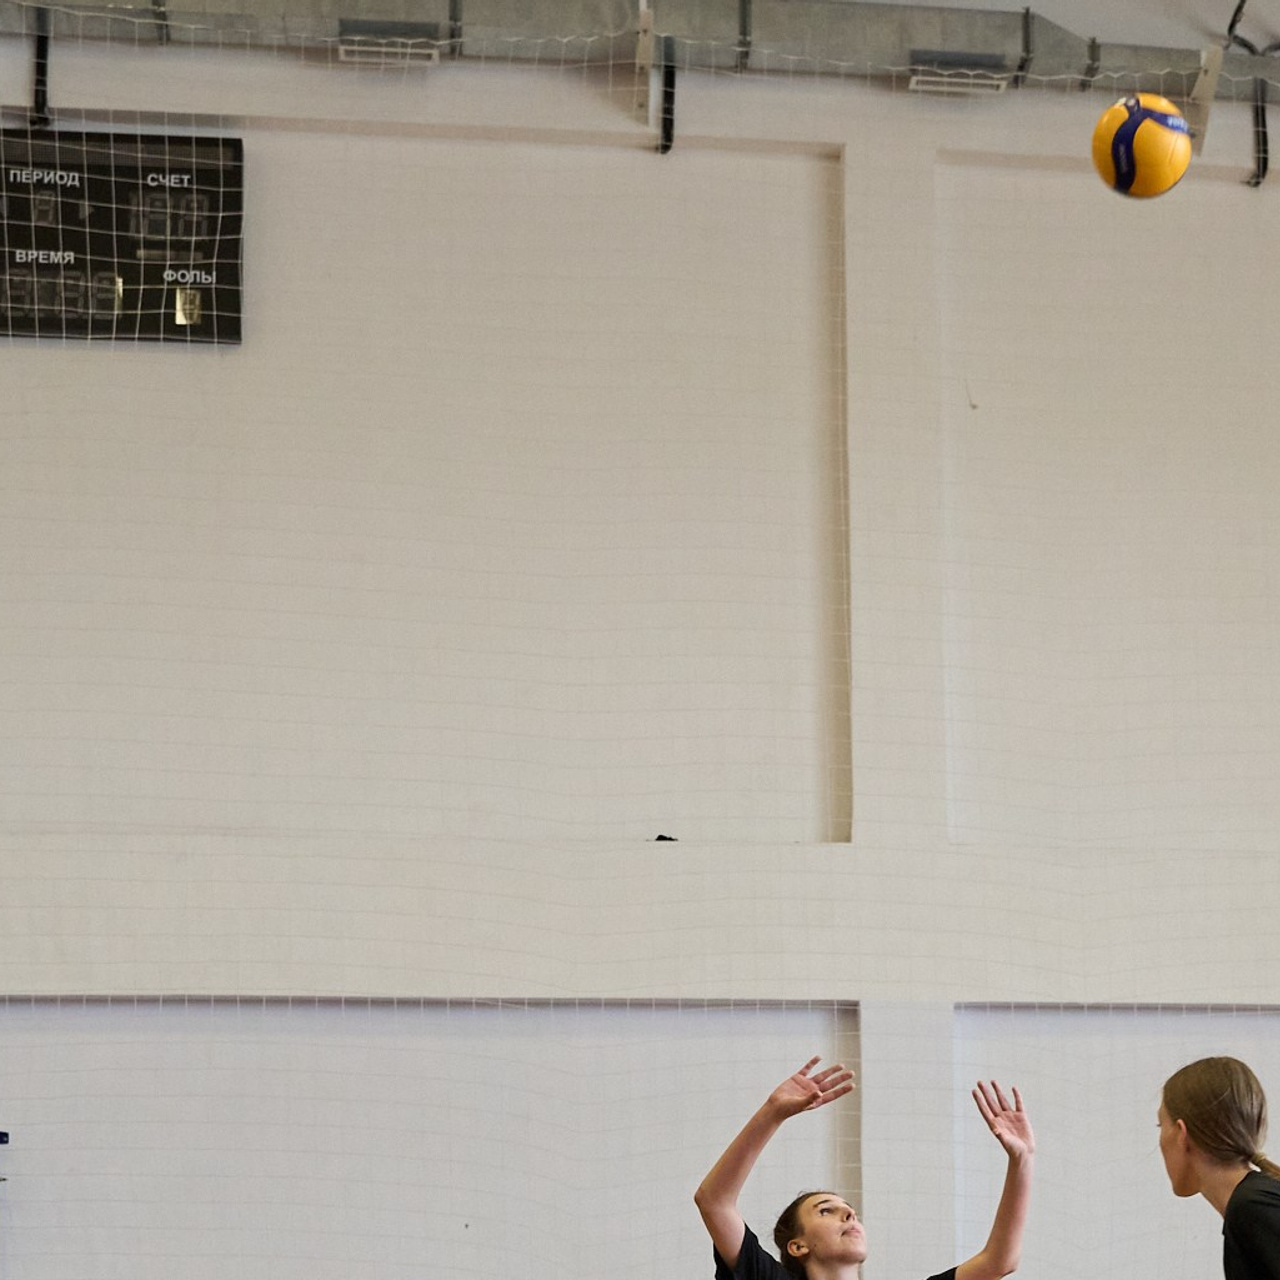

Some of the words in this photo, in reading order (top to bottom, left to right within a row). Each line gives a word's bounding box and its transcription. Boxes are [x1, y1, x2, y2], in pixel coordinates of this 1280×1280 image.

[9, 169, 80, 188] ПЕРИОД
[146, 173, 191, 187] СЧЕТ
[15, 249, 75, 265] ВРЕМЯ
[163, 269, 217, 284] ФОЛЫ
